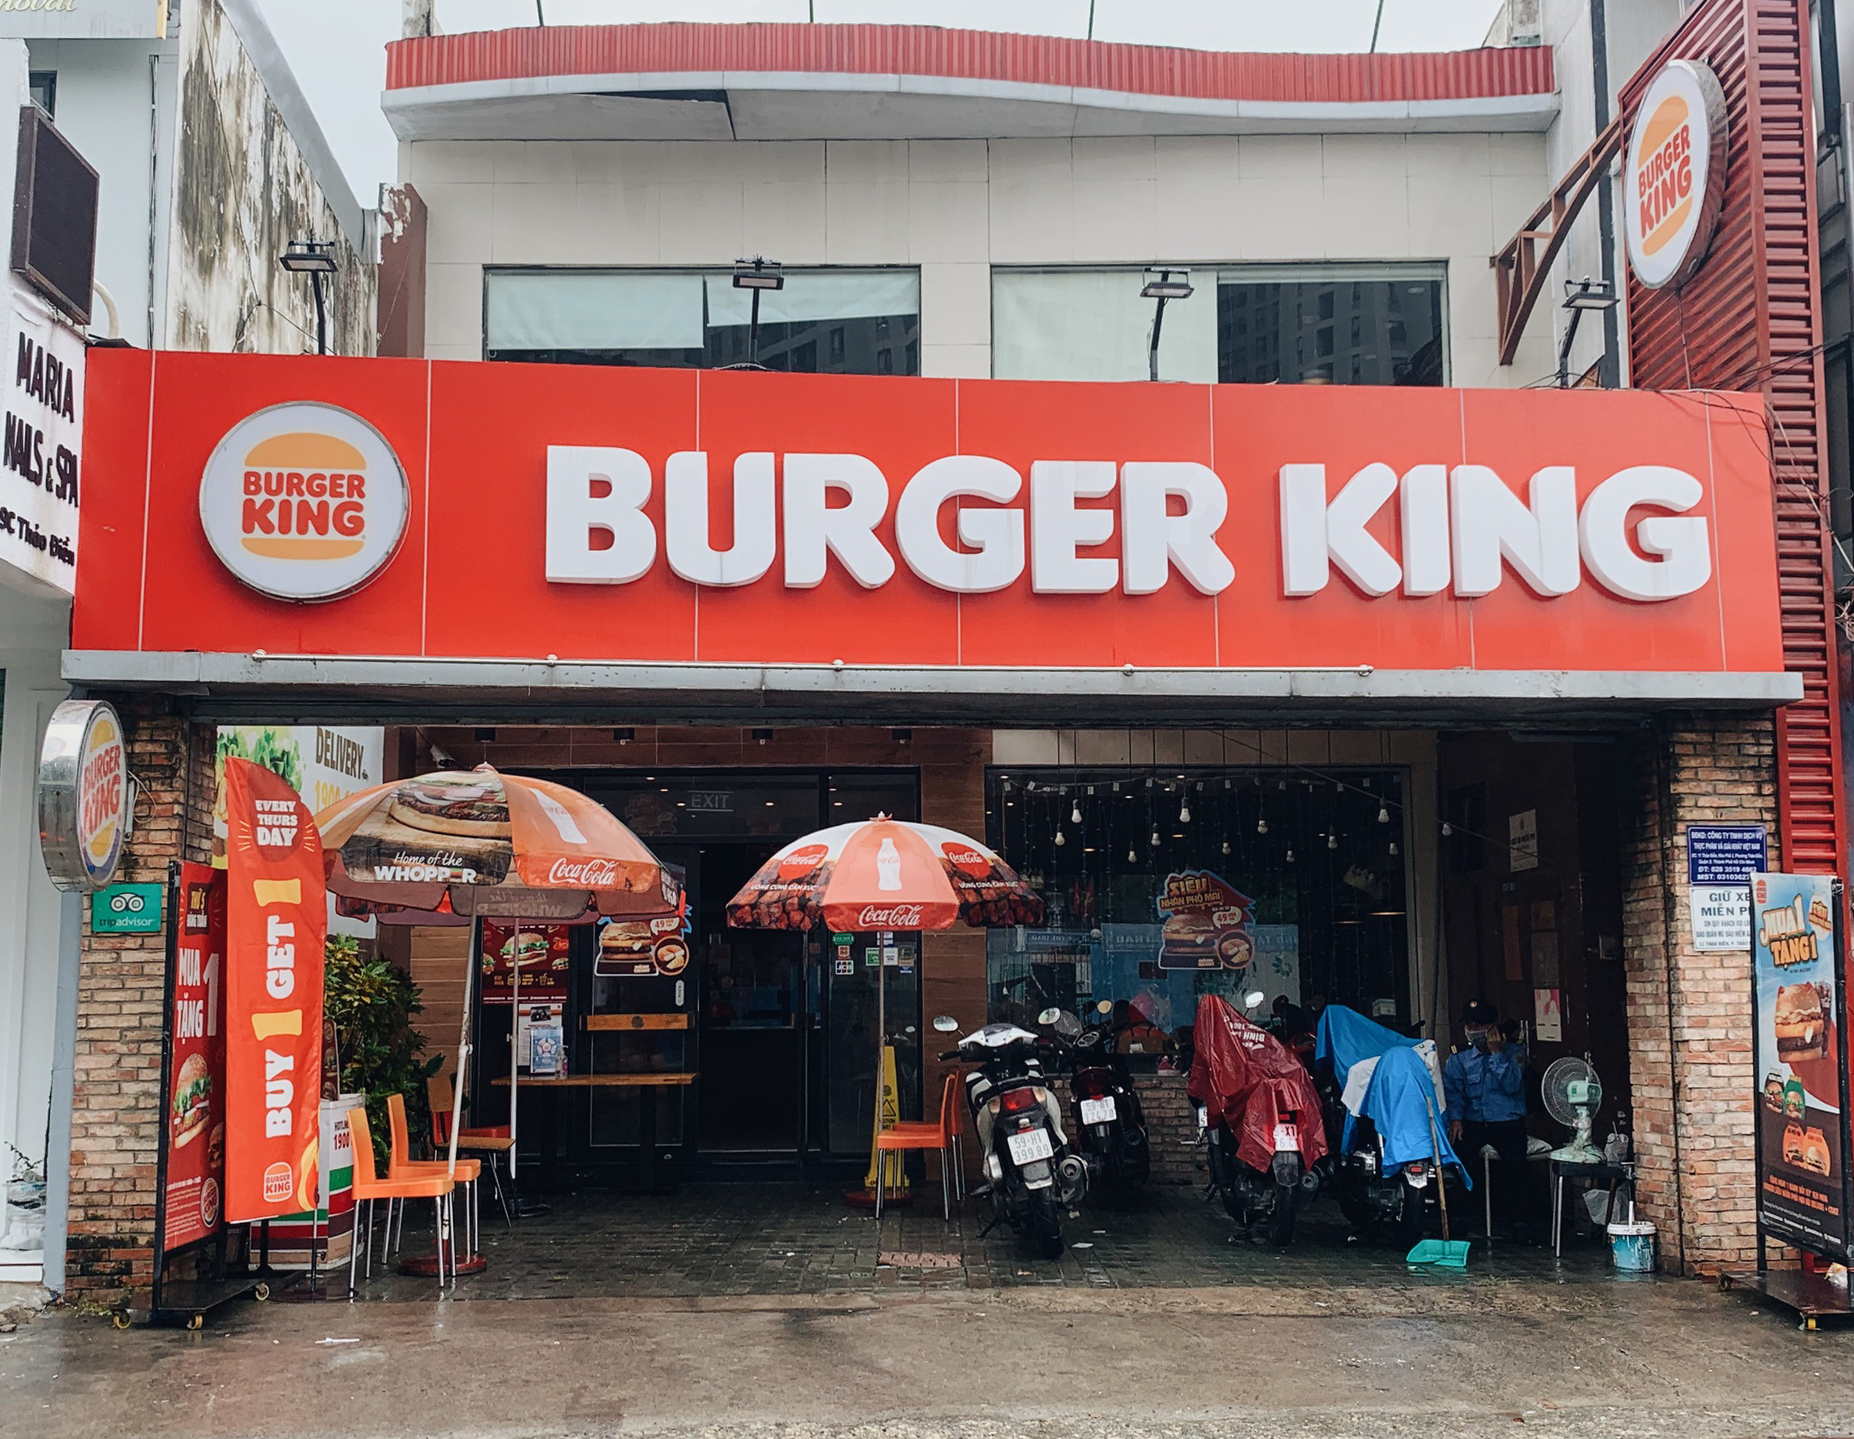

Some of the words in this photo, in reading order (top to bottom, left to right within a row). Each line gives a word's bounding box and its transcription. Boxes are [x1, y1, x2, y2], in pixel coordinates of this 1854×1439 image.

[1638, 124, 1690, 199] BURGER
[1639, 155, 1692, 239] KING
[17, 331, 75, 424] MARIA
[3, 411, 44, 486] NAILS
[45, 457, 54, 493] &
[56, 444, 79, 508] SPA
[243, 471, 366, 499] BURGER
[242, 498, 365, 537] KING
[545, 444, 1235, 594] BURGER
[1279, 462, 1712, 602] KING
[316, 726, 364, 780] DELIVERY
[83, 744, 121, 799] BURGER
[83, 773, 121, 843] KING
[255, 800, 297, 813] EVERY
[691, 794, 730, 809] EXIT
[257, 813, 298, 826] THURS
[256, 827, 298, 847] DAY
[393, 851, 425, 864] Home
[427, 850, 443, 867] of
[442, 850, 463, 866] the
[549, 857, 620, 885] Coca-Cola
[949, 852, 983, 863] Coca-Cola
[253, 877, 303, 907] 1
[1169, 876, 1207, 897] SIÊU
[1709, 890, 1732, 902] GIỮ
[1736, 892, 1750, 902] XE
[99, 916, 153, 928] tripadvisor
[858, 904, 924, 927] Coca-Cola
[1739, 906, 1751, 916] P
[1759, 905, 1798, 947] MUA
[265, 914, 296, 1000] GET
[178, 947, 201, 987] MUA
[203, 953, 219, 1037] 1
[251, 1008, 303, 1041] 1
[264, 1048, 296, 1139] BUY
[1013, 1143, 1051, 1163] 399.89
[1014, 1132, 1043, 1149] 59-H1
[265, 1181, 291, 1195] KING
[266, 1174, 291, 1184] BURGER
